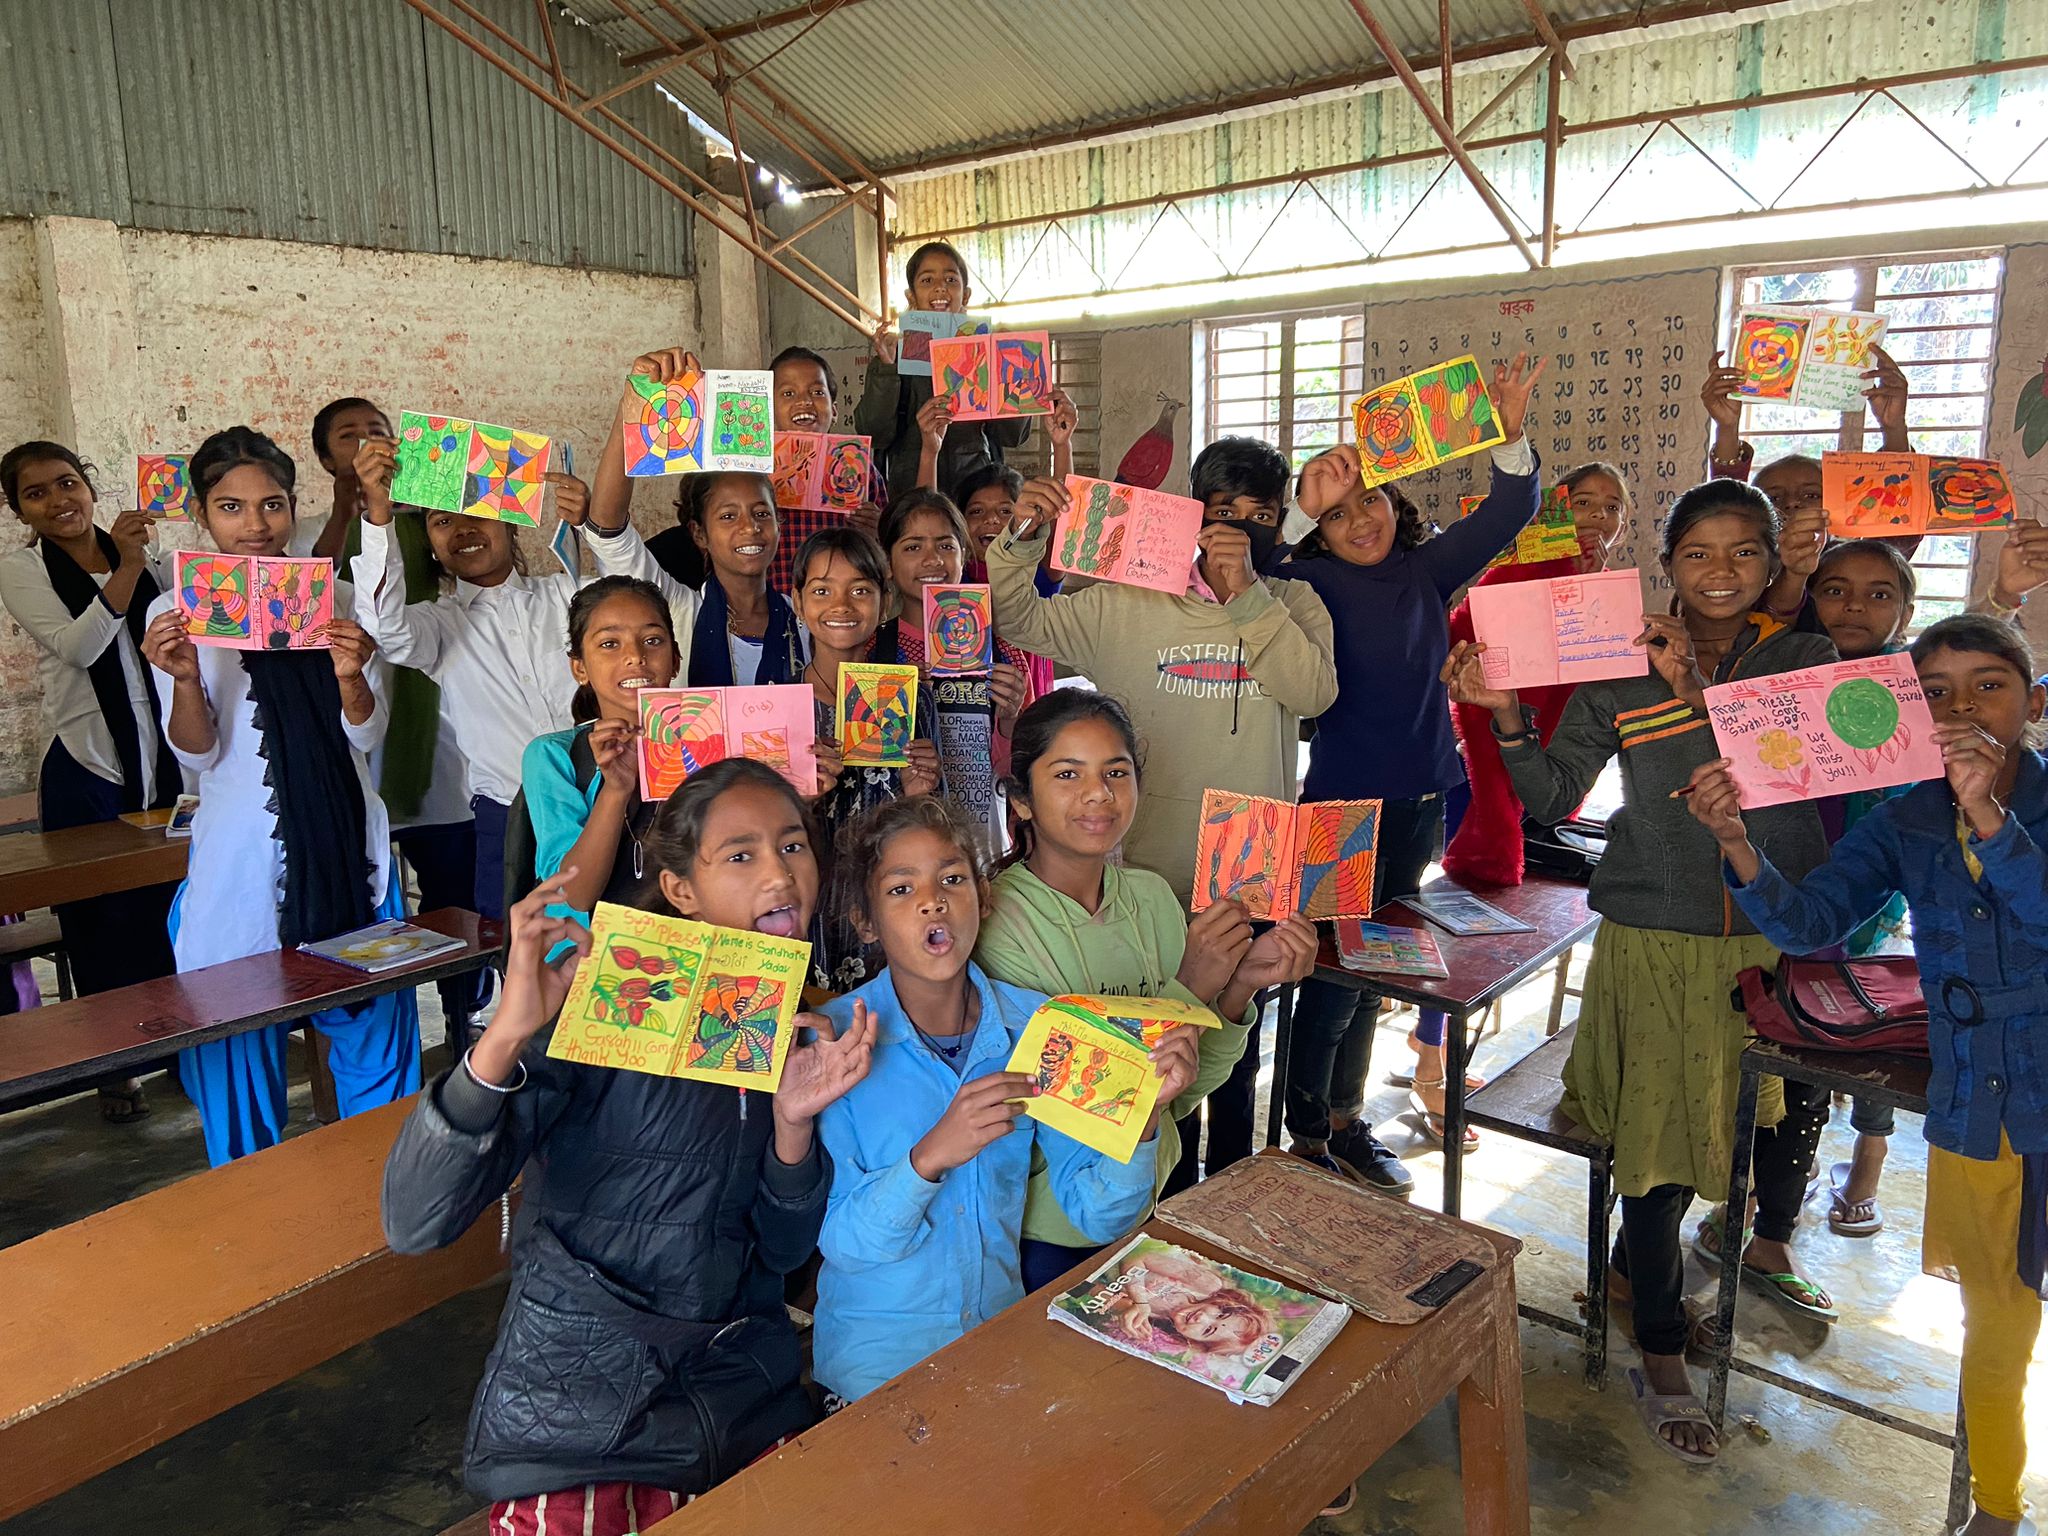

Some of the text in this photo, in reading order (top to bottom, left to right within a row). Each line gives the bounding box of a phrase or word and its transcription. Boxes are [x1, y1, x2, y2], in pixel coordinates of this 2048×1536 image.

[1664, 315, 1684, 332] १०
[1556, 353, 1574, 371] १७
[1625, 347, 1643, 368] १९
[1662, 345, 1684, 367] २०
[1554, 380, 1574, 402] २७
[1622, 376, 1642, 399] २९
[1660, 373, 1681, 399] ३०
[1553, 409, 1571, 431] ३७
[1622, 405, 1641, 429] ३९
[1659, 403, 1680, 420] ४०
[1553, 437, 1571, 453] ४७
[1621, 434, 1640, 455] ४९
